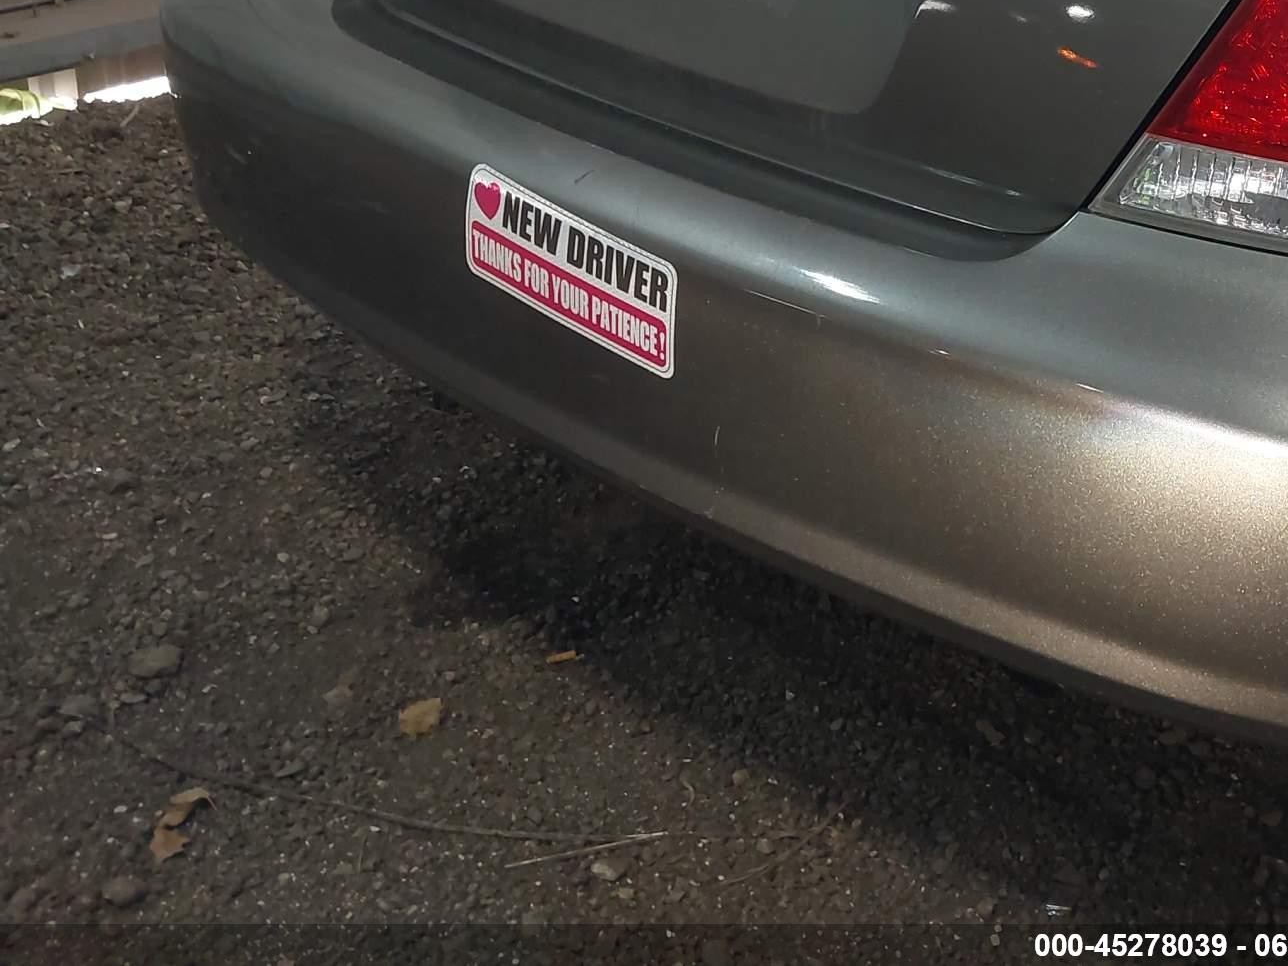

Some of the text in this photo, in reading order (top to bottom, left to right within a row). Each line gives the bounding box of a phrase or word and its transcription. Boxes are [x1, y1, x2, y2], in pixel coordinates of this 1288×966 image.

[473, 231, 666, 361] THANKS FOR YOUR PATIENCE!
[502, 191, 669, 313] NEW DRIVER
